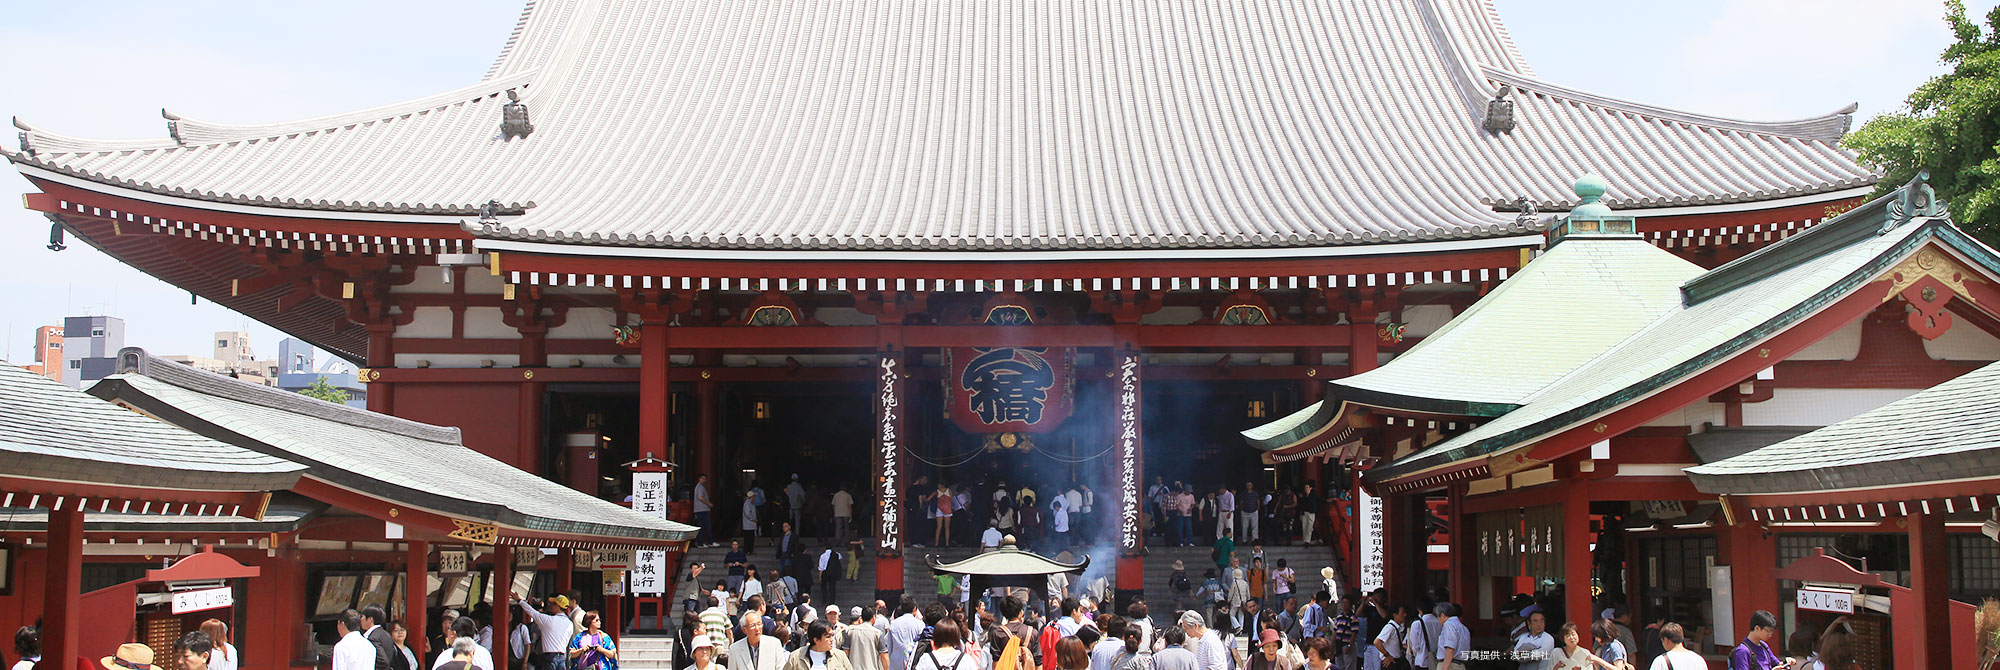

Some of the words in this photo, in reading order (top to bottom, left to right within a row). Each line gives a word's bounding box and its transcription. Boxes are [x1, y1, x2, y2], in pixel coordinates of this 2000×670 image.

[639, 479, 661, 489] 恒例
[1801, 593, 1830, 608] みくじ
